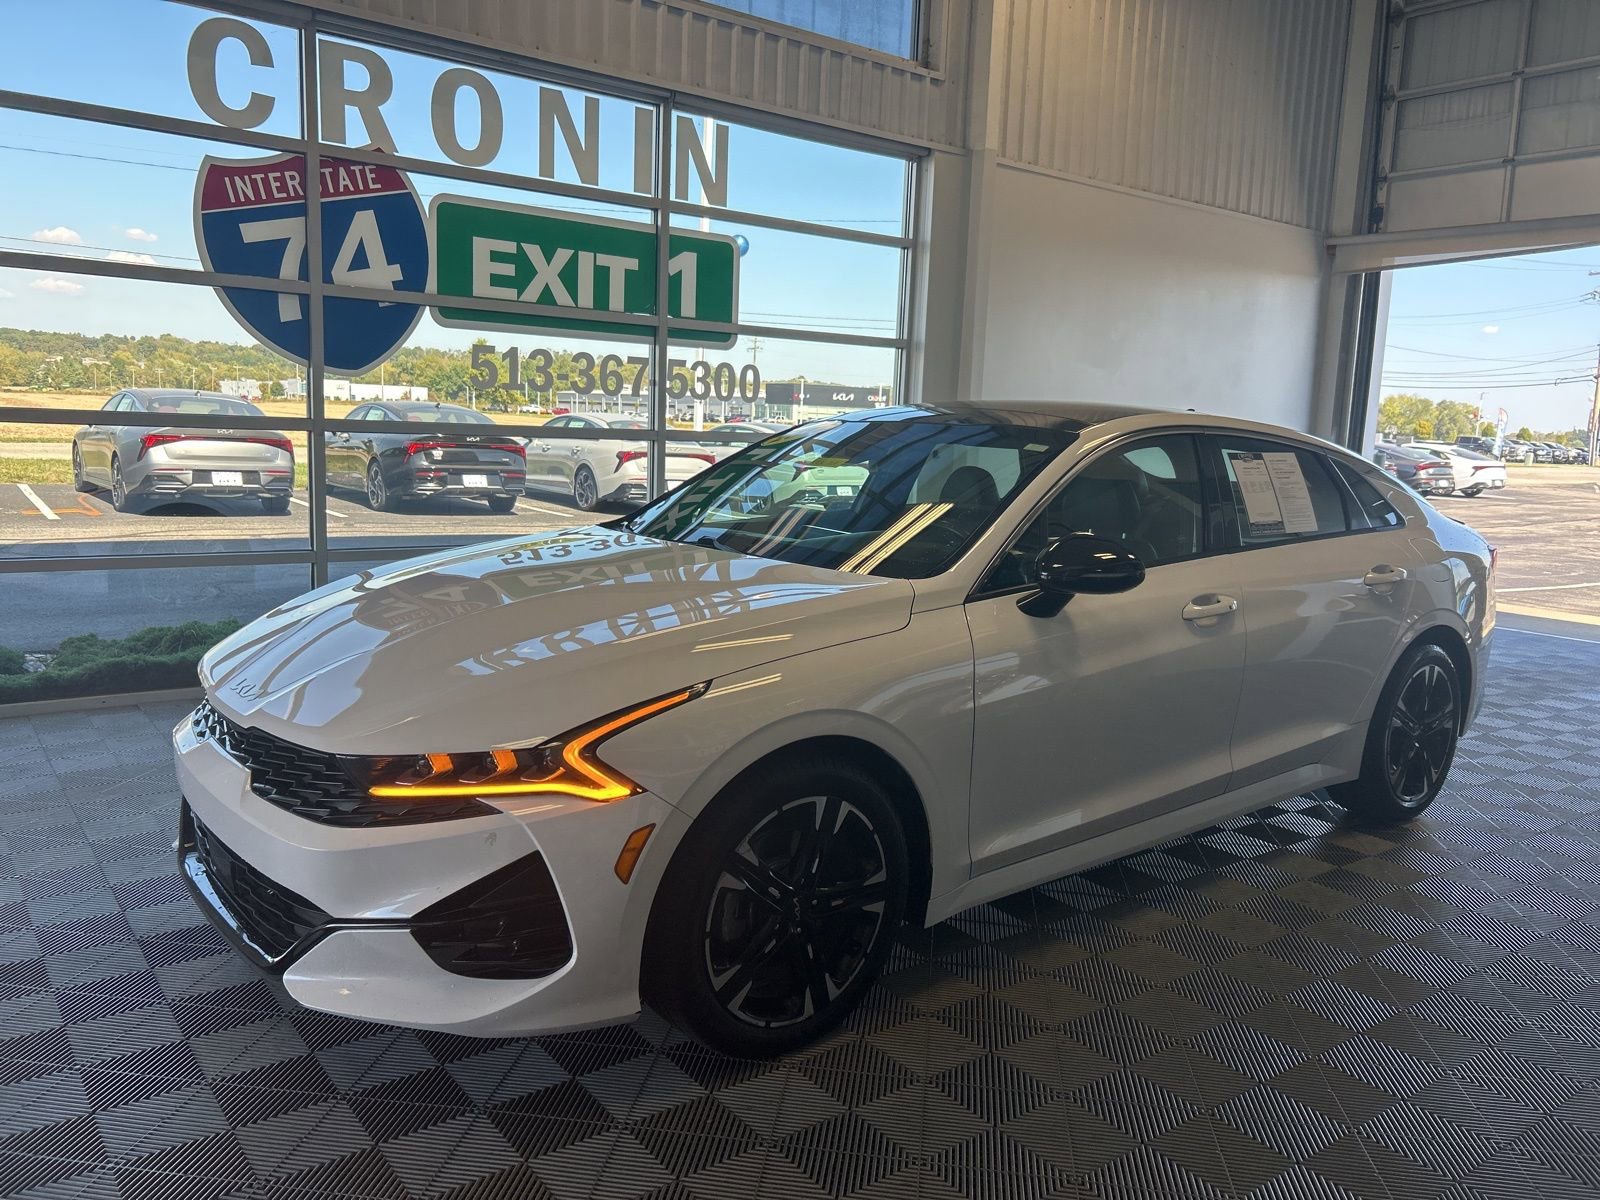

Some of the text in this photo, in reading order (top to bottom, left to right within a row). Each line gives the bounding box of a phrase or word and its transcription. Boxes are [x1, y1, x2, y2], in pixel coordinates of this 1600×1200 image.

[187, 17, 730, 207] CRONIN
[224, 165, 382, 203] INTERTATE
[239, 209, 404, 323] 74
[472, 236, 698, 318] EXIT 1
[469, 343, 761, 403] 513-3675300
